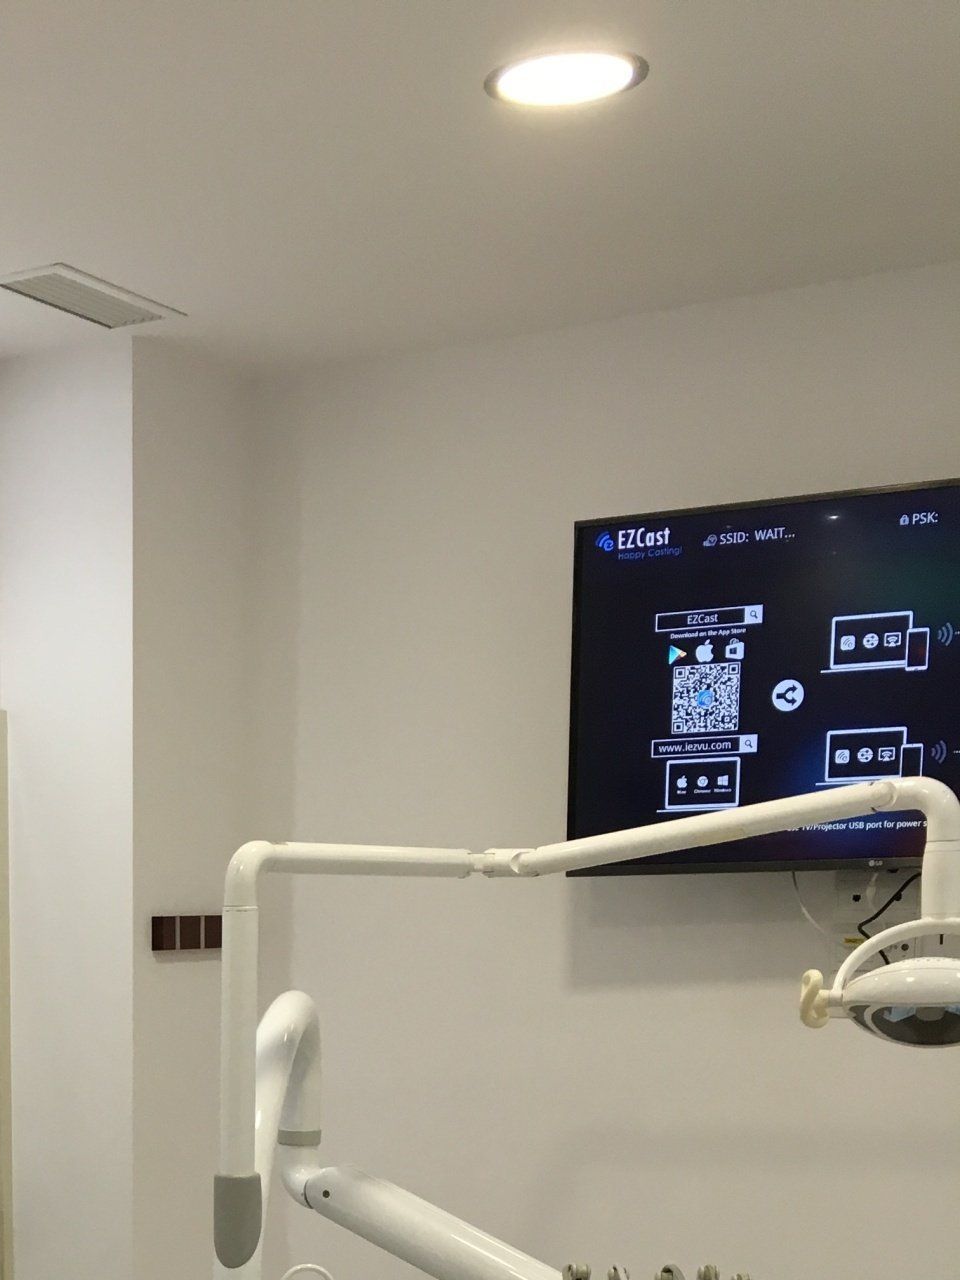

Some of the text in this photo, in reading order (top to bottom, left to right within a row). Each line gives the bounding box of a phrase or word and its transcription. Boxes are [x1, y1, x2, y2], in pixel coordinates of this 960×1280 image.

[912, 511, 939, 525] PSK:
[618, 527, 671, 550] EZCast
[719, 527, 795, 545] SSID: WAIT...
[618, 546, 683, 561] Happy Casting!
[687, 614, 718, 625] EZCast
[670, 631, 698, 639] Download
[718, 628, 730, 636] App
[658, 741, 732, 753] www.iezvu.com
[848, 821, 865, 829] USB
[866, 821, 882, 830] port
[883, 820, 895, 828] for
[896, 820, 921, 830] power
